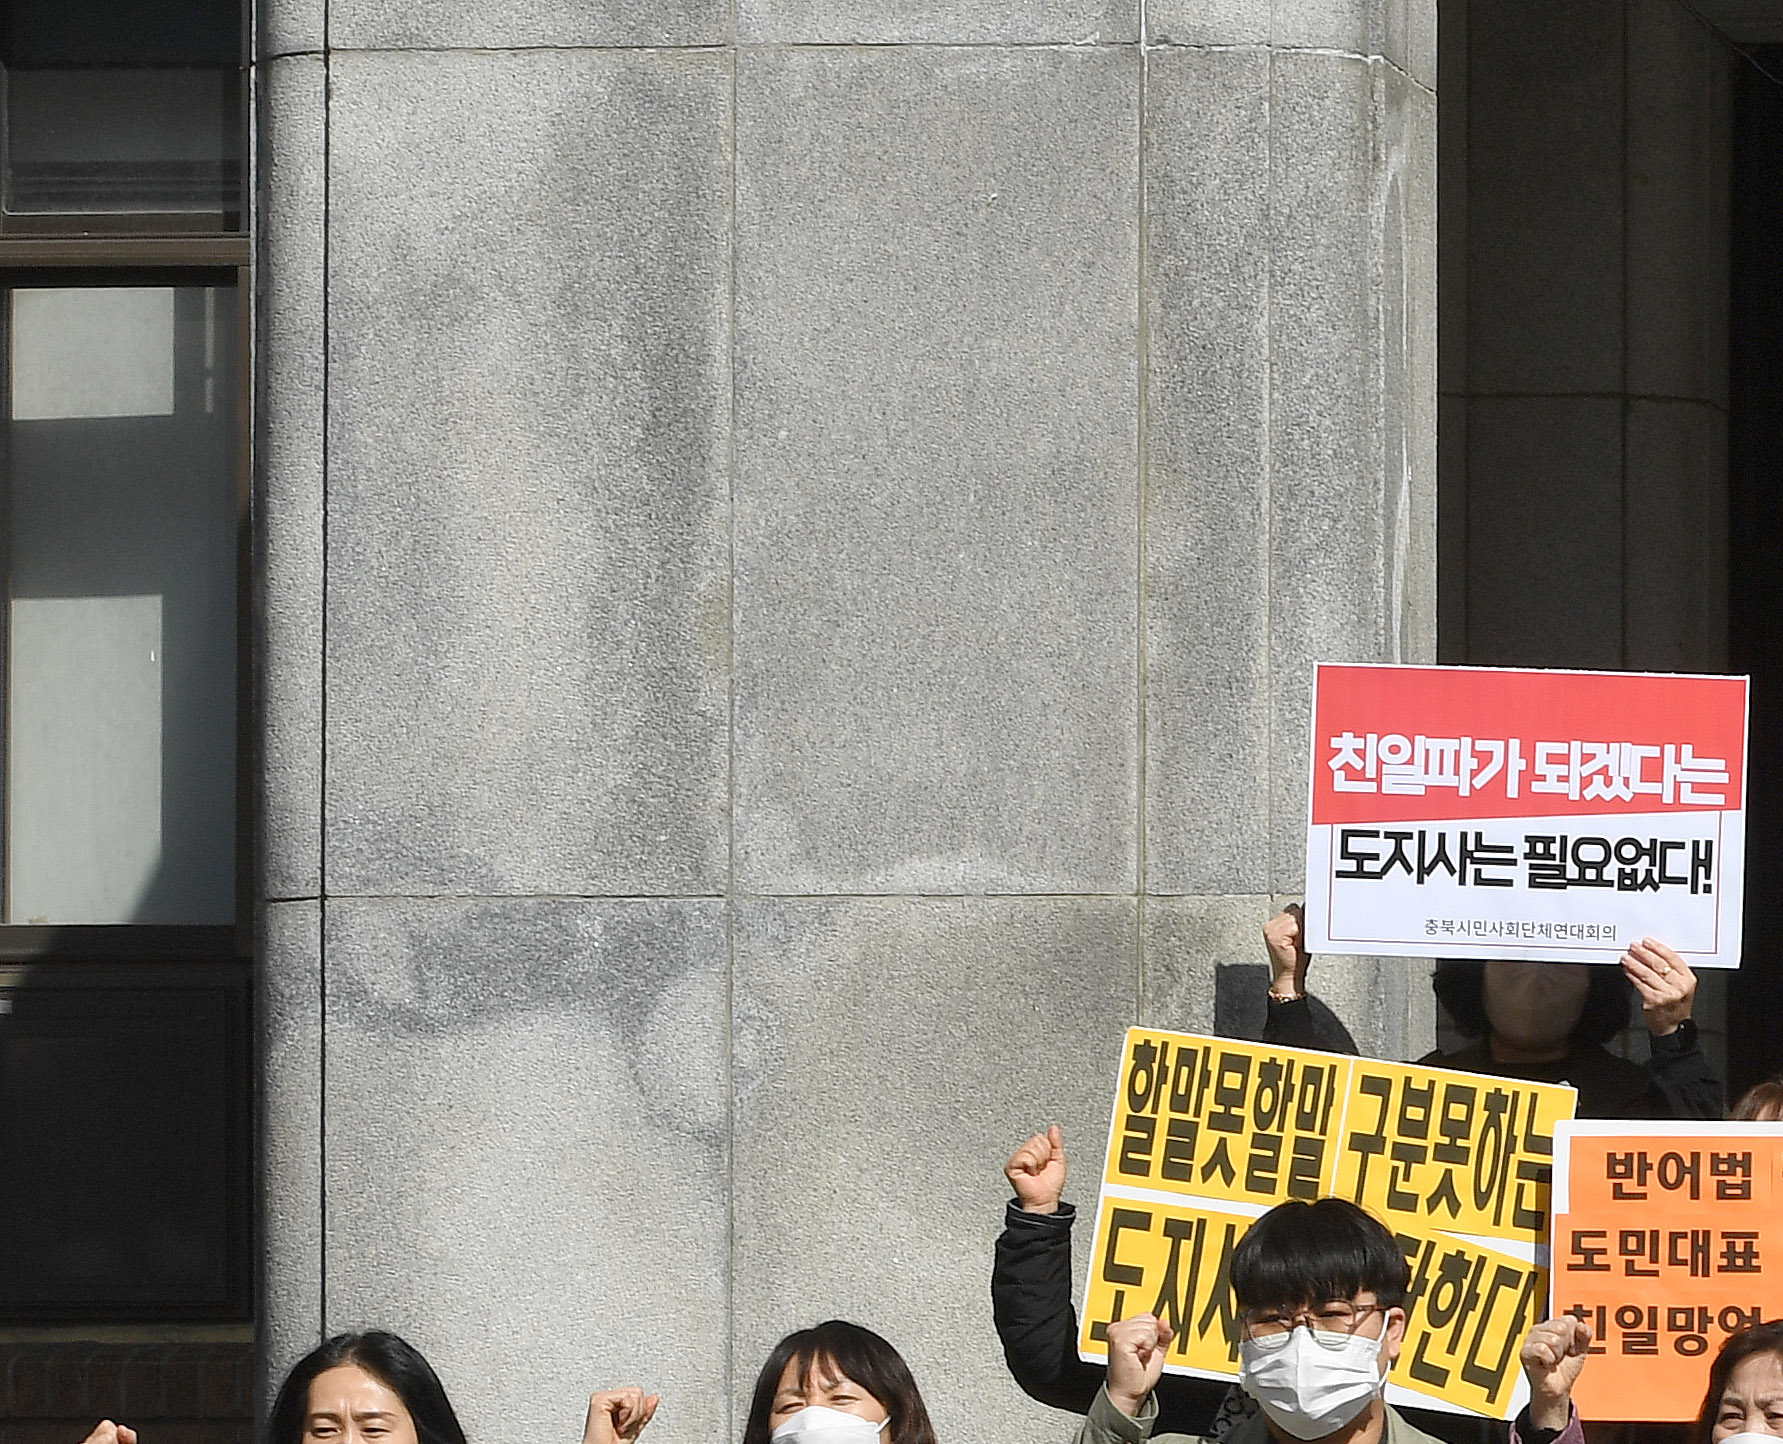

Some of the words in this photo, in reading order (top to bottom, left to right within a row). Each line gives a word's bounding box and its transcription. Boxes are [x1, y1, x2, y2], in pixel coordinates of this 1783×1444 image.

[1328, 732, 1526, 799] 친일파가
[1531, 740, 1730, 806] 되겠다는
[1334, 829, 1518, 887] 도지사는
[1523, 834, 1714, 894] 필요없다!
[1424, 919, 1618, 942] 충북시민사회단체연대회의
[1119, 1038, 1338, 1198] 할말못할말
[1346, 1072, 1554, 1232] 구분못하는
[1606, 1152, 1753, 1201] 반어법
[1566, 1229, 1762, 1279] 도민대표
